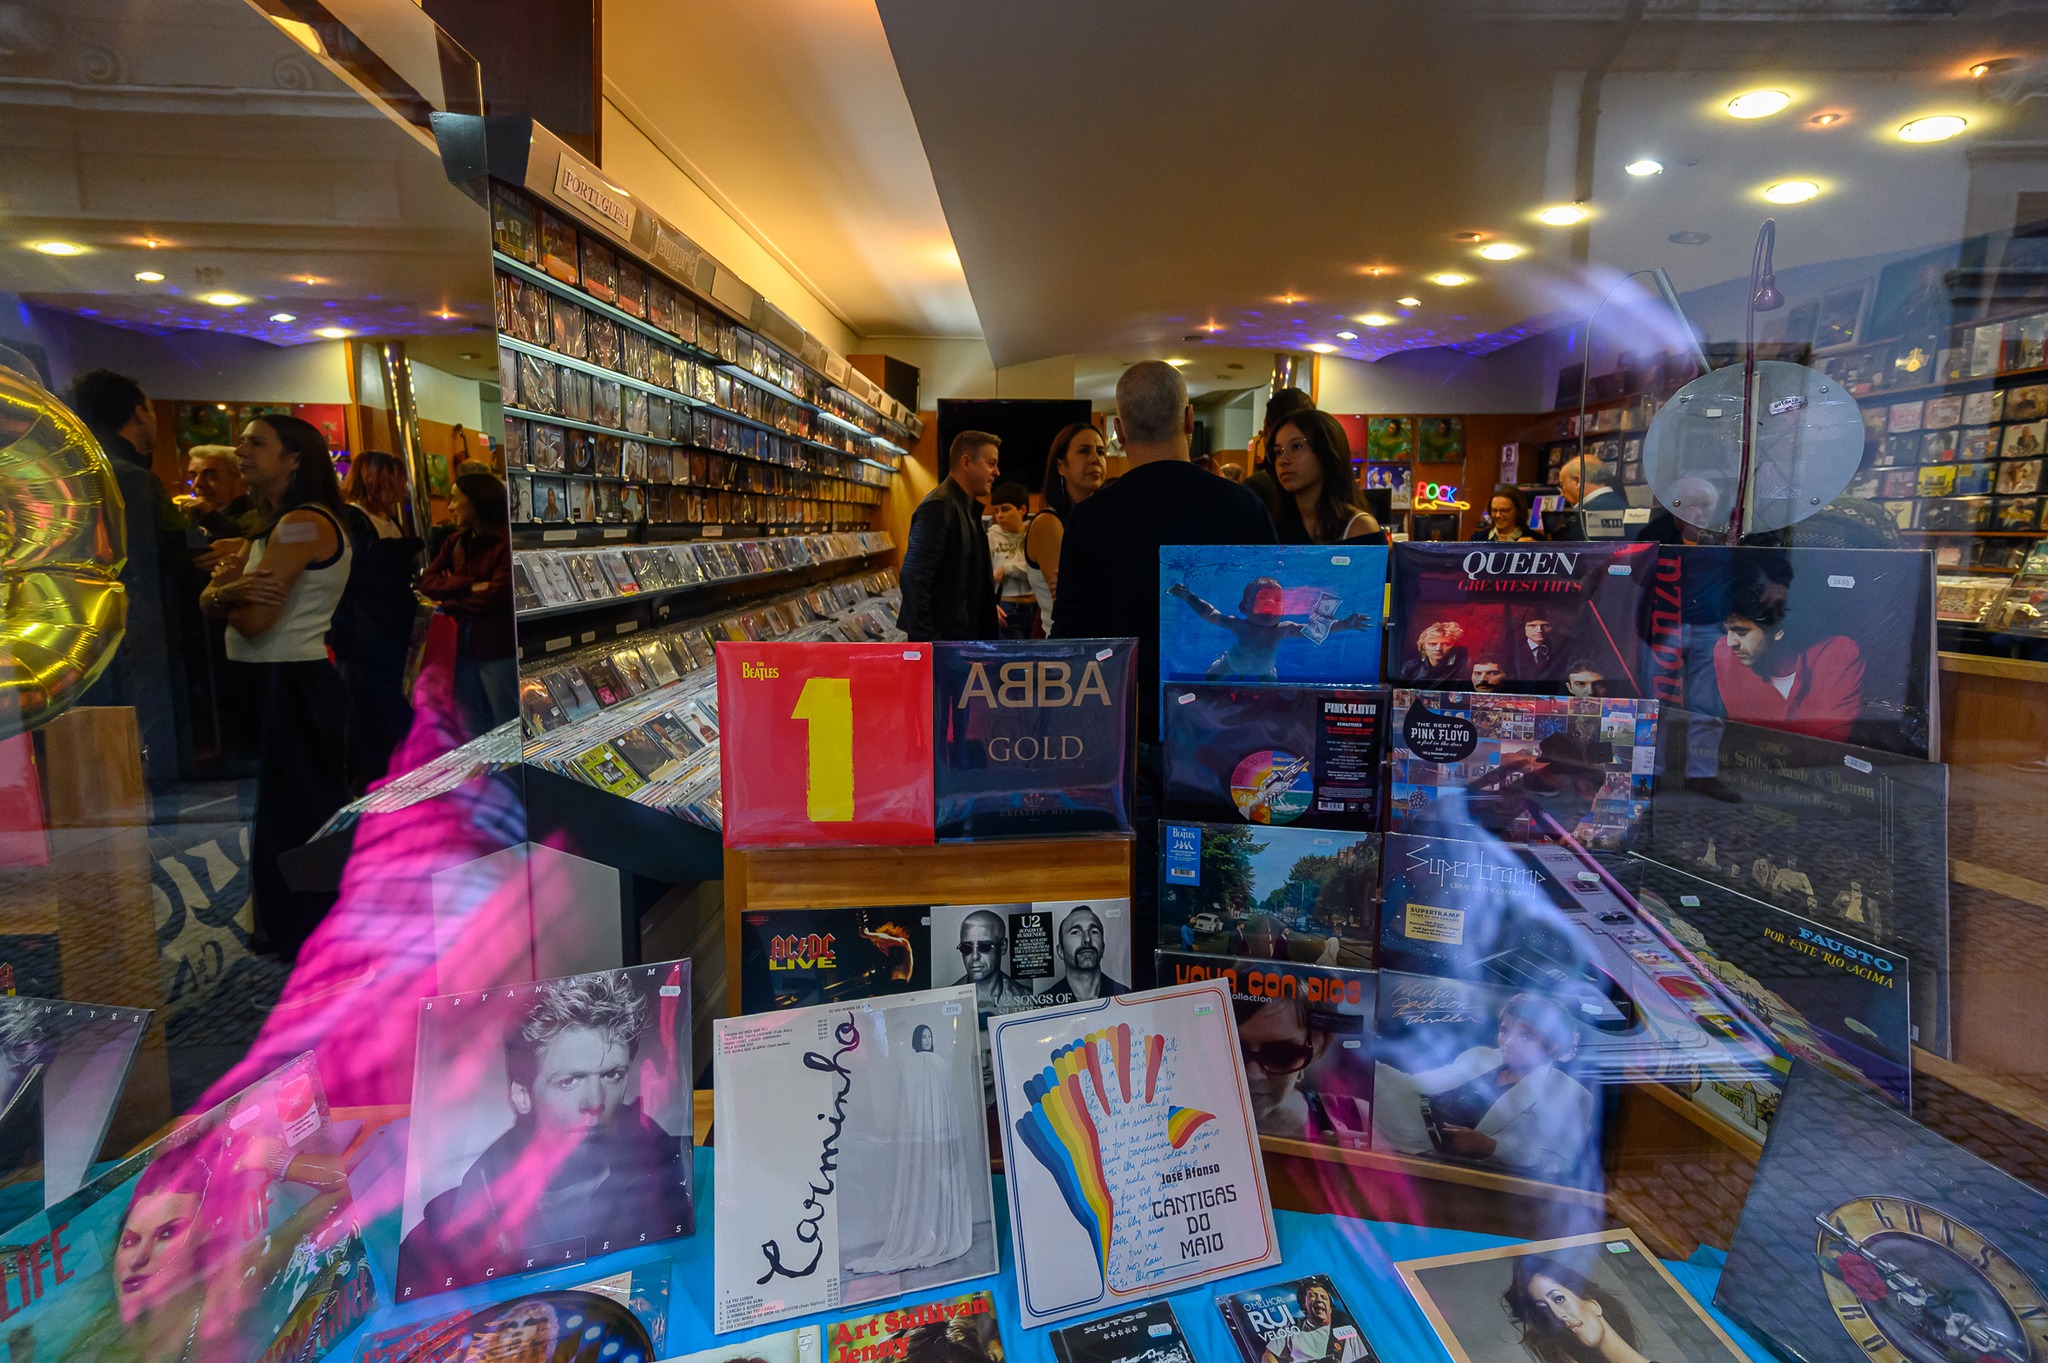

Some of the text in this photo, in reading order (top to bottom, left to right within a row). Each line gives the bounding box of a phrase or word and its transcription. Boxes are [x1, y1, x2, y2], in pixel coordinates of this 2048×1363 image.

[565, 170, 629, 229] PORTUGUESA
[1417, 481, 1457, 502] ROCK
[1463, 551, 1581, 579] QUEEN
[1458, 578, 1582, 592] GREATEST HITS
[957, 660, 1112, 709] ABBA
[1324, 702, 1376, 715] PINK FLOYD
[1410, 727, 1469, 742] PINK FLOYD
[790, 677, 854, 822] 1
[988, 735, 1084, 762] GOLD
[1406, 844, 1546, 899] Supertramp
[1021, 915, 1041, 928] U2
[1410, 907, 1460, 918] SUPERTRAMP
[770, 932, 836, 961] AC/DC
[1763, 927, 1894, 989] POR ESTE RIO ACIMA
[1798, 926, 1893, 972] FAUSTO
[569, 964, 680, 989] ADAMS
[769, 956, 837, 971] LIVE
[426, 985, 543, 1011] BRYAN
[994, 993, 1073, 1006] U2 SONGS OF
[1231, 991, 1272, 1003] ollection
[1248, 971, 1296, 999] CON
[1308, 976, 1362, 1004] DIOS
[1392, 997, 1480, 1018] Jackson
[757, 1011, 860, 1285] Carminho
[1186, 1163, 1220, 1180] Afonso
[240, 1177, 273, 1241] OF
[1152, 1184, 1237, 1219] CANTIGAS
[1186, 1213, 1211, 1235] DO
[1180, 1232, 1224, 1259] MAIO
[0, 1222, 75, 1323] LIFE
[404, 1225, 682, 1296] RECKLESS
[1243, 1296, 1285, 1311] O MELHOR
[833, 1298, 989, 1345] Art Sullivan
[1084, 1311, 1148, 1334] XUTOS
[1247, 1304, 1296, 1333] RUI
[1258, 1325, 1301, 1342] VELOSO
[834, 1336, 910, 1363] Jenny
